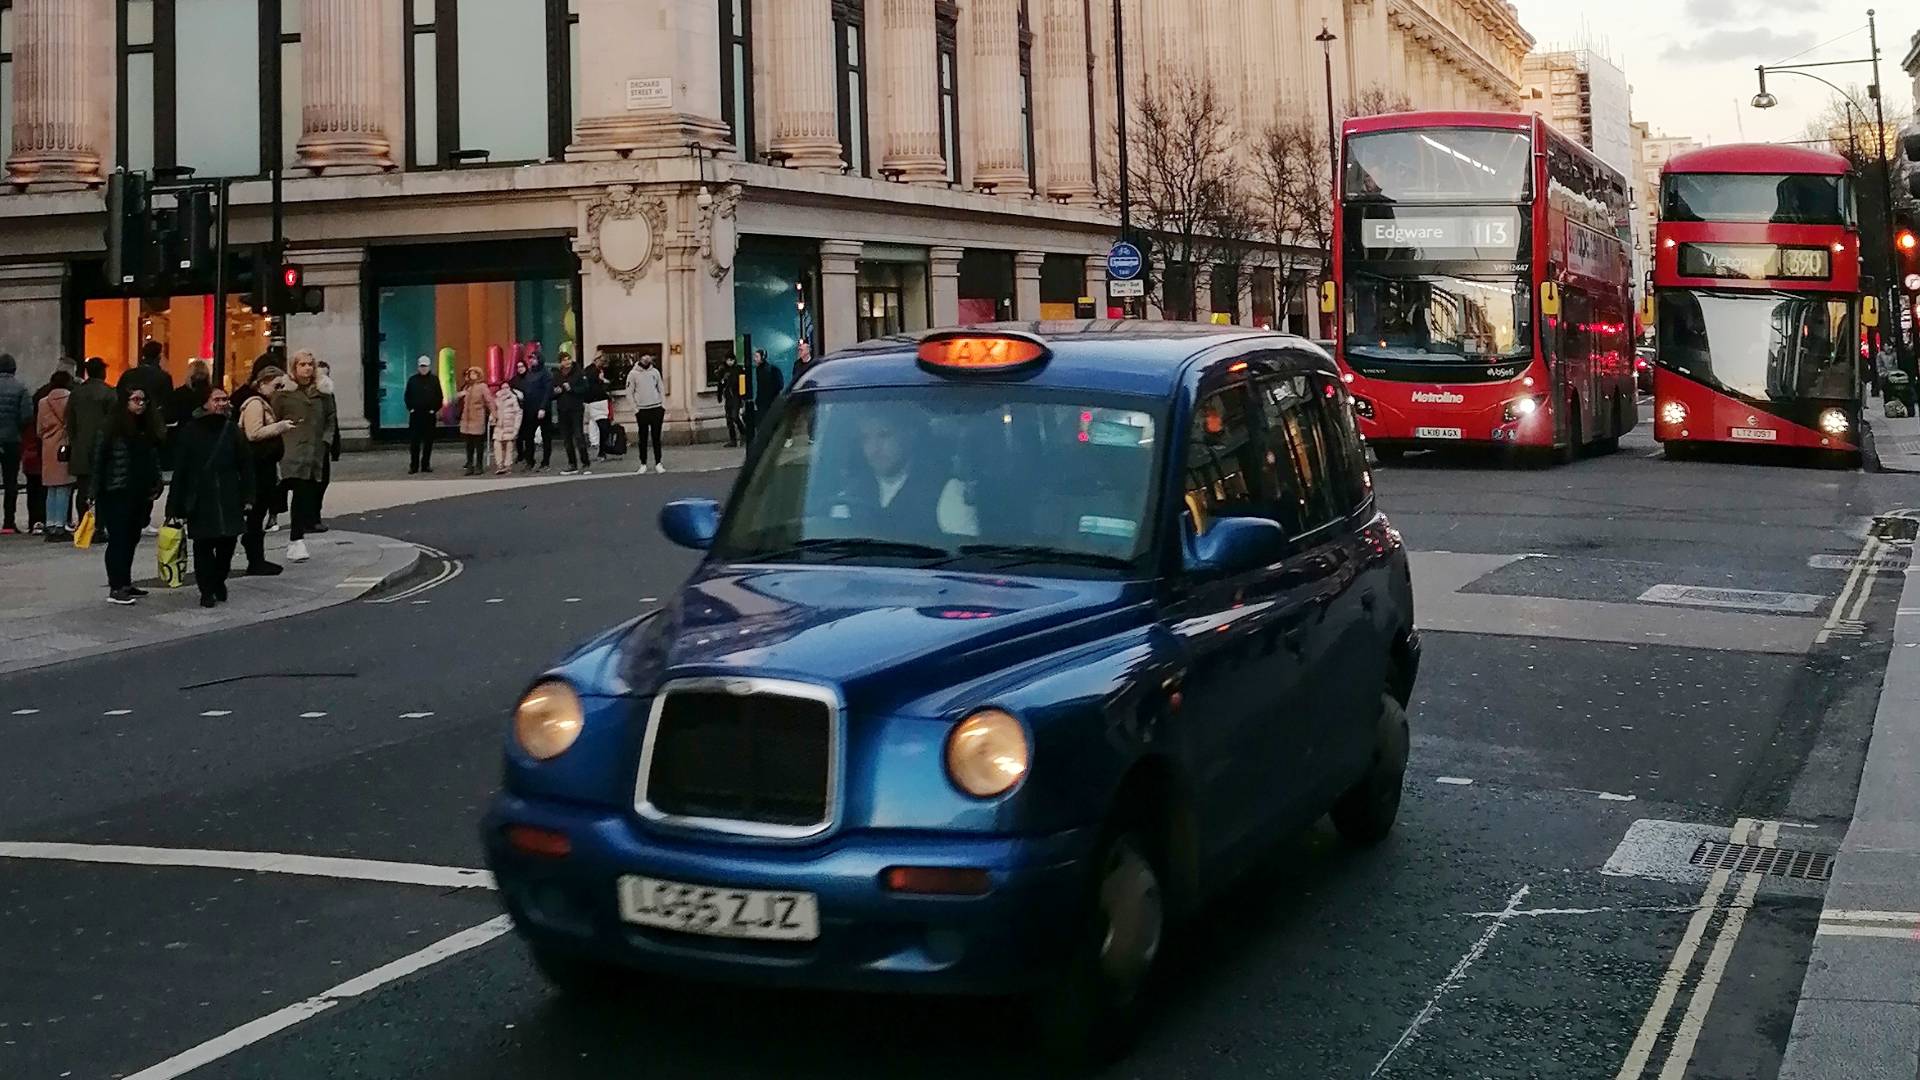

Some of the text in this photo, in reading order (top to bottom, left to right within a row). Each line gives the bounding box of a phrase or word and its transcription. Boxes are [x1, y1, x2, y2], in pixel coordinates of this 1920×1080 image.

[1375, 222, 1507, 244] Edgware 113
[1790, 253, 1822, 273] 390
[936, 341, 1012, 363] TAXI
[1411, 391, 1464, 403] Metroline
[1420, 428, 1459, 438] LK18 AGX
[727, 893, 801, 929] ZJZ
